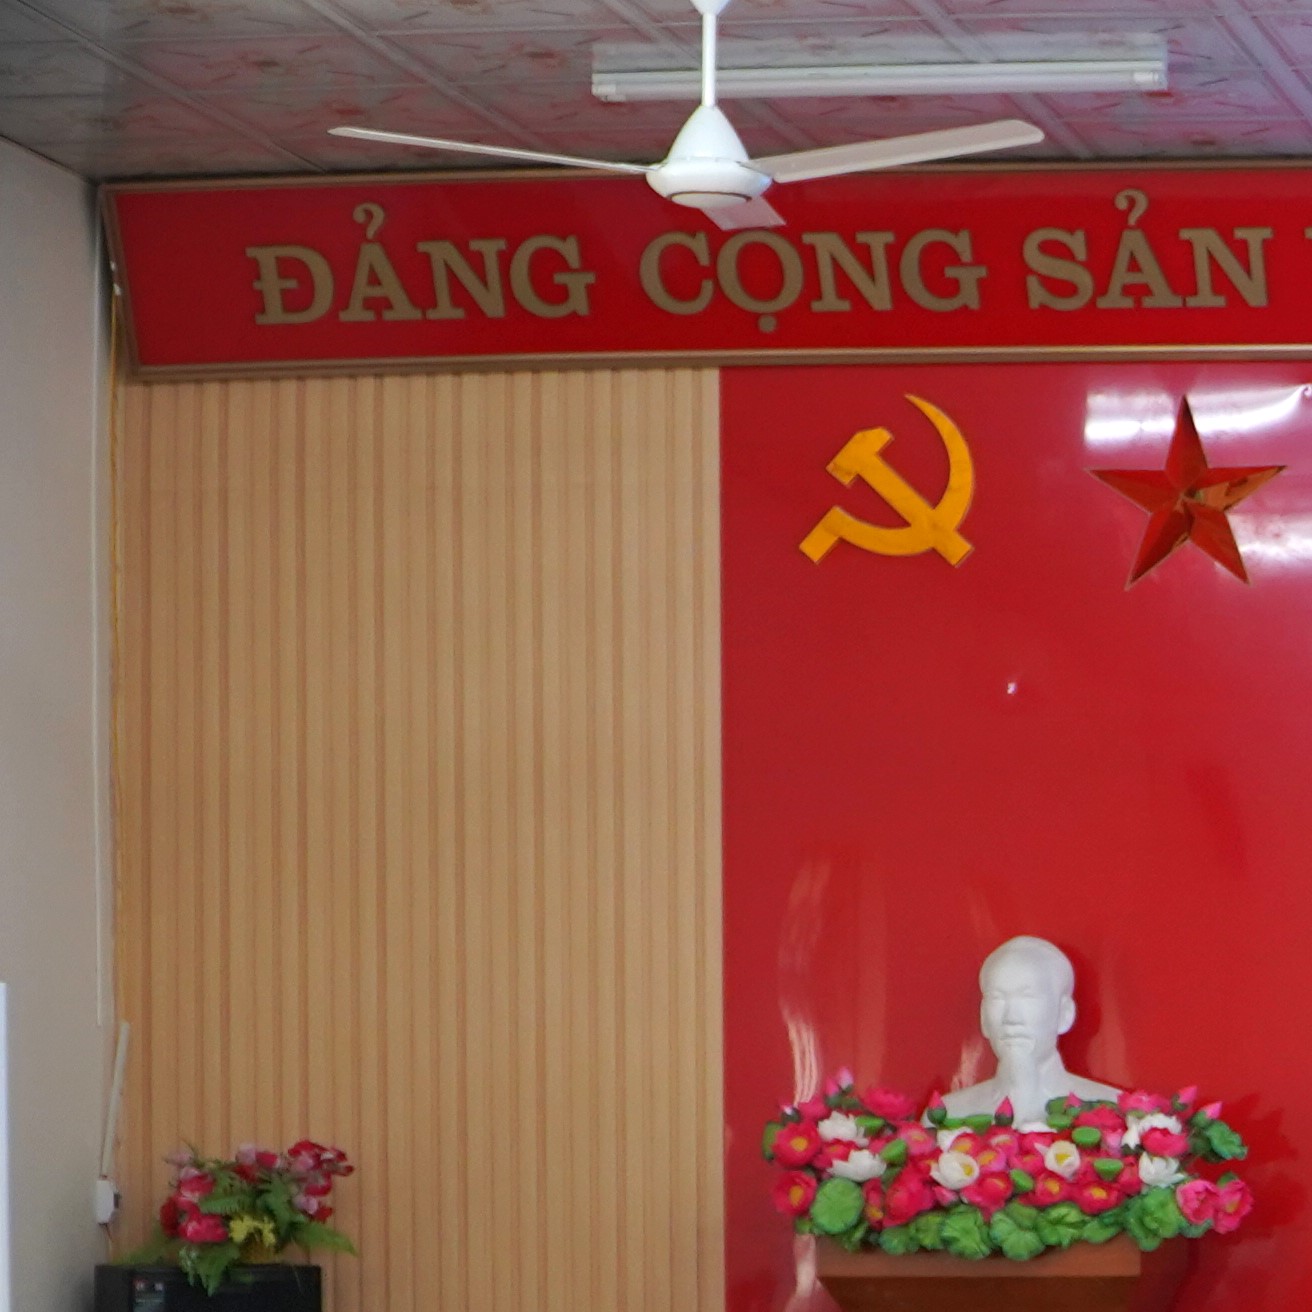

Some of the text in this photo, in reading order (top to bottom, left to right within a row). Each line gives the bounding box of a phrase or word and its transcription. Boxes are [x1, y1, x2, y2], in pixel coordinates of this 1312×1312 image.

[247, 204, 594, 323] ĐẢNG
[641, 228, 986, 331] CỘNG
[1024, 190, 1272, 310] SẢN
